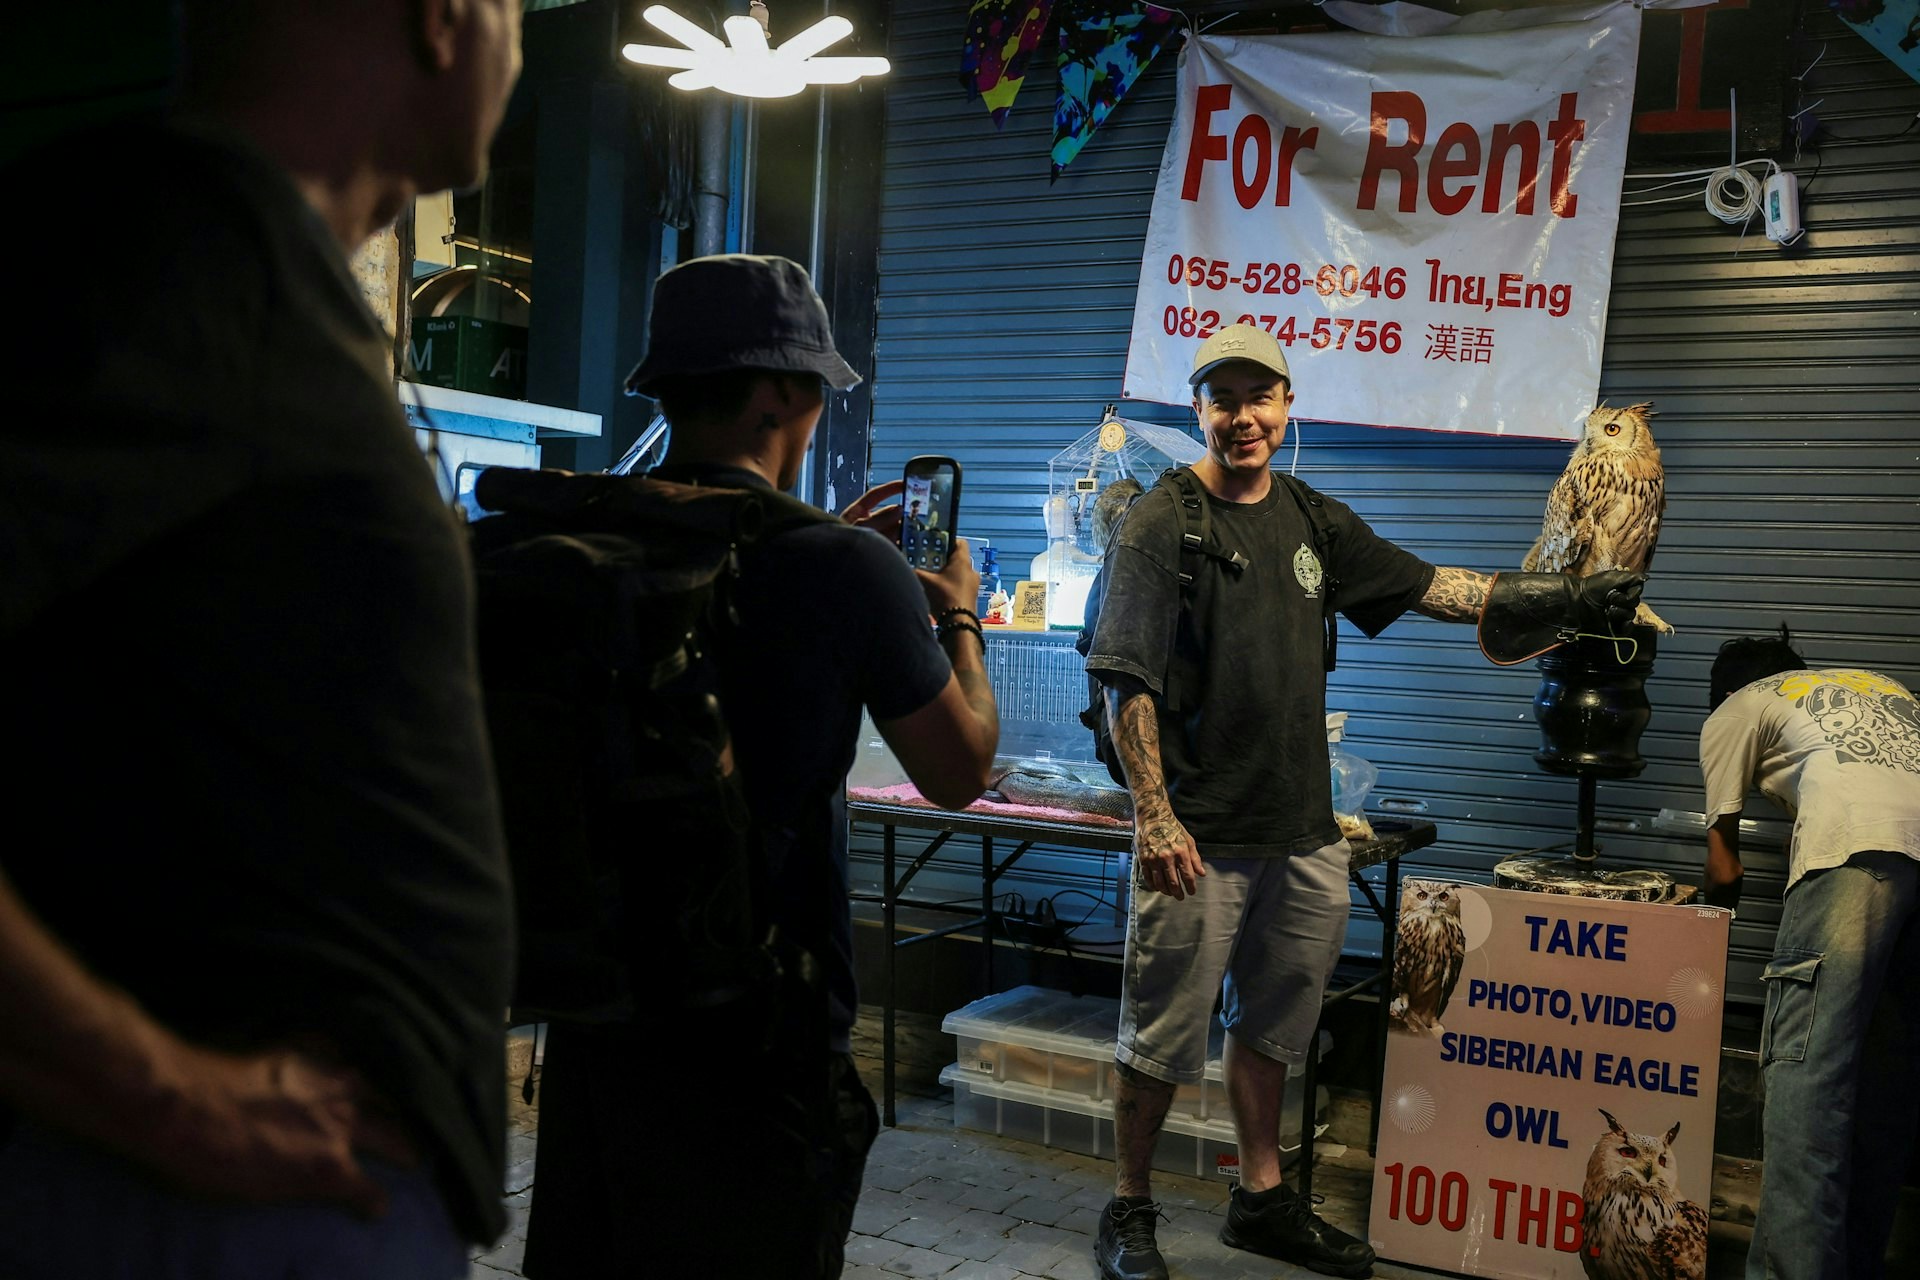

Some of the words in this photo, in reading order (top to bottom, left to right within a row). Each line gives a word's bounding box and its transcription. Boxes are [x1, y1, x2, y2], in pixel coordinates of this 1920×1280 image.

[1181, 84, 1317, 209] For
[1357, 91, 1586, 218] Rent
[1168, 254, 1407, 300] 065-528-6046
[1424, 322, 1495, 364] 漢語
[1525, 915, 1628, 961] TAKE
[1468, 979, 1676, 1032] PHOTO,VIDEO
[1440, 1032, 1583, 1080] SIBERIAN
[1594, 1053, 1699, 1097] EAGLE
[1485, 1102, 1568, 1149] OWL
[1384, 1162, 1469, 1232] 100
